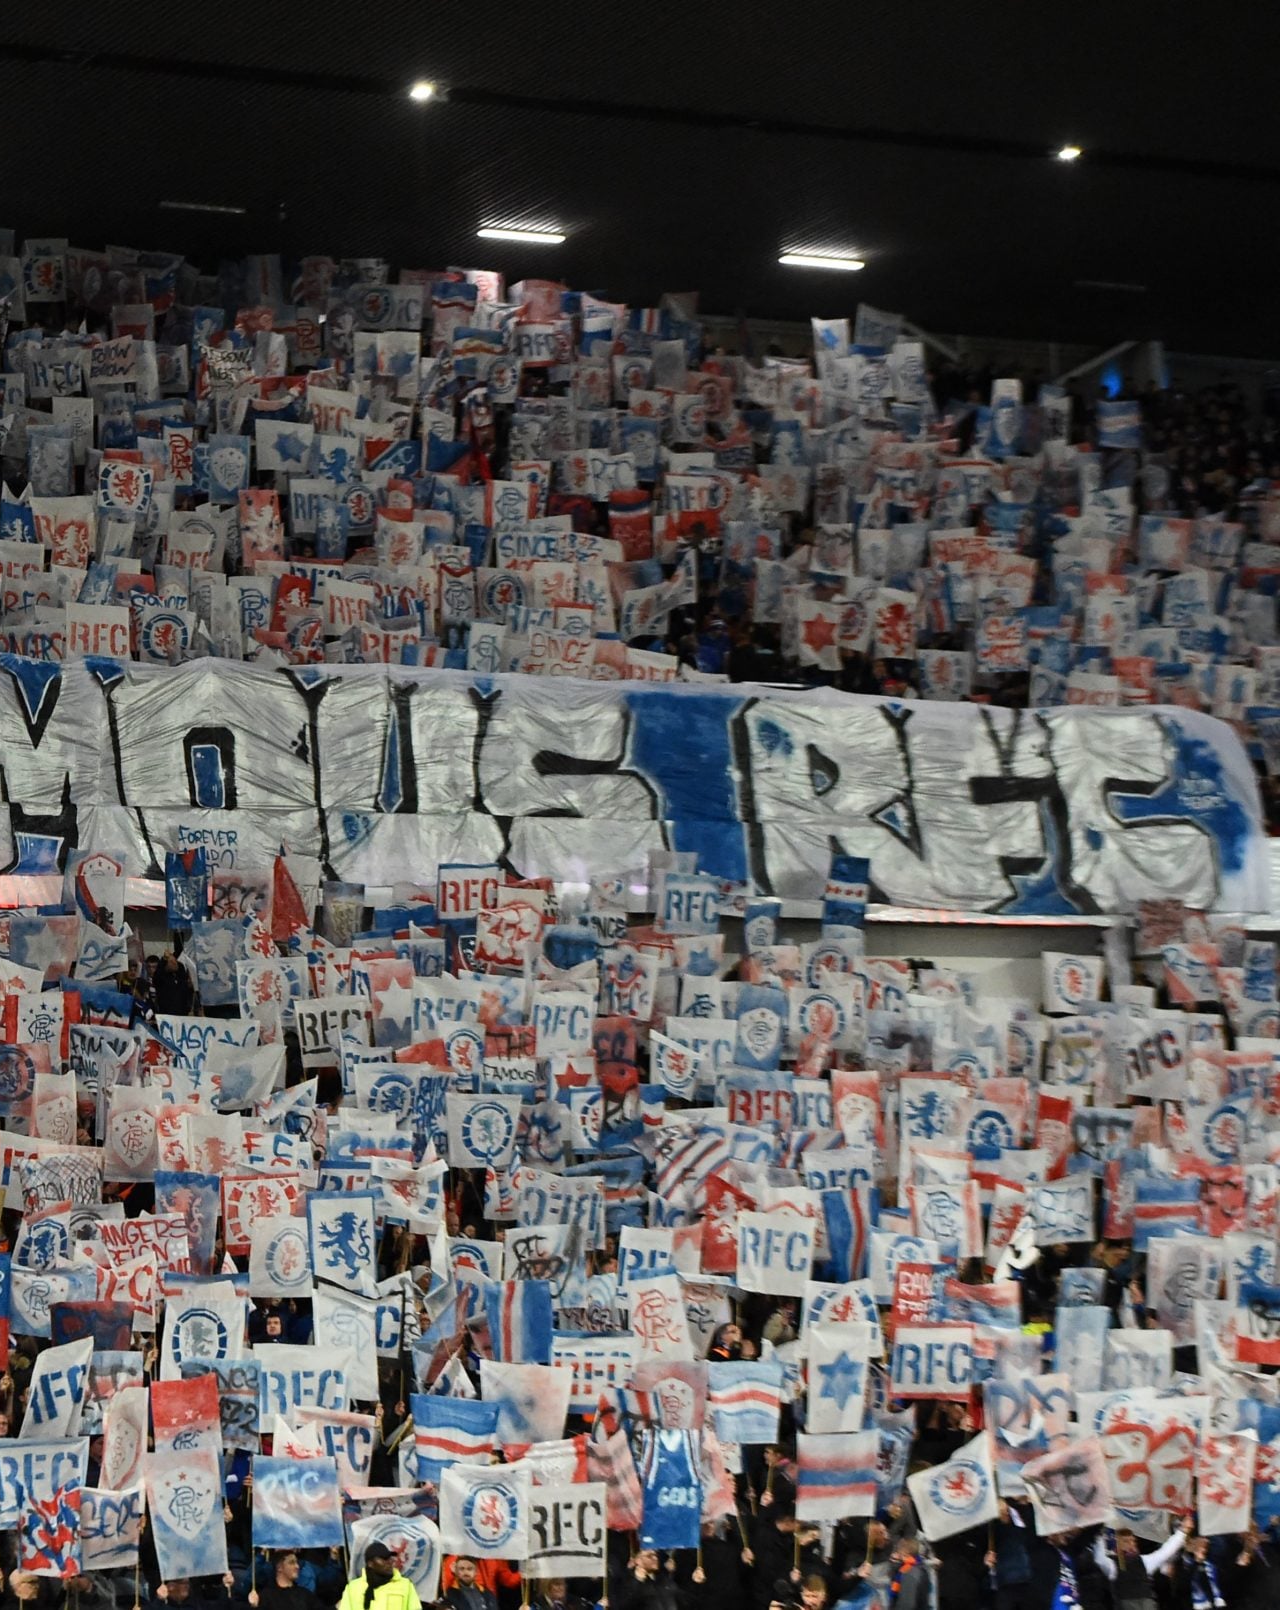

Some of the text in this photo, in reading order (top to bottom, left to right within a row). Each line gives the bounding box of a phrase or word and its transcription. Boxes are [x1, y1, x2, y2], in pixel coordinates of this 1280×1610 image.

[499, 534, 557, 559] SINCE
[69, 620, 127, 656] RFC
[730, 690, 1226, 916] RFC
[178, 825, 238, 847] FOREVER
[441, 877, 498, 913] RFC
[665, 889, 721, 924] RFC
[299, 1010, 363, 1048] RFC
[412, 998, 478, 1032] RFC
[532, 1004, 591, 1042] RFC
[483, 1062, 536, 1083] FAMOUS
[729, 1090, 791, 1122] RFC
[98, 1219, 189, 1250] ANGERS
[739, 1227, 812, 1273] RFC
[897, 1343, 972, 1385] RFC
[260, 1370, 345, 1414] RFC
[320, 1424, 371, 1474] FC
[531, 1500, 603, 1549] RFC
